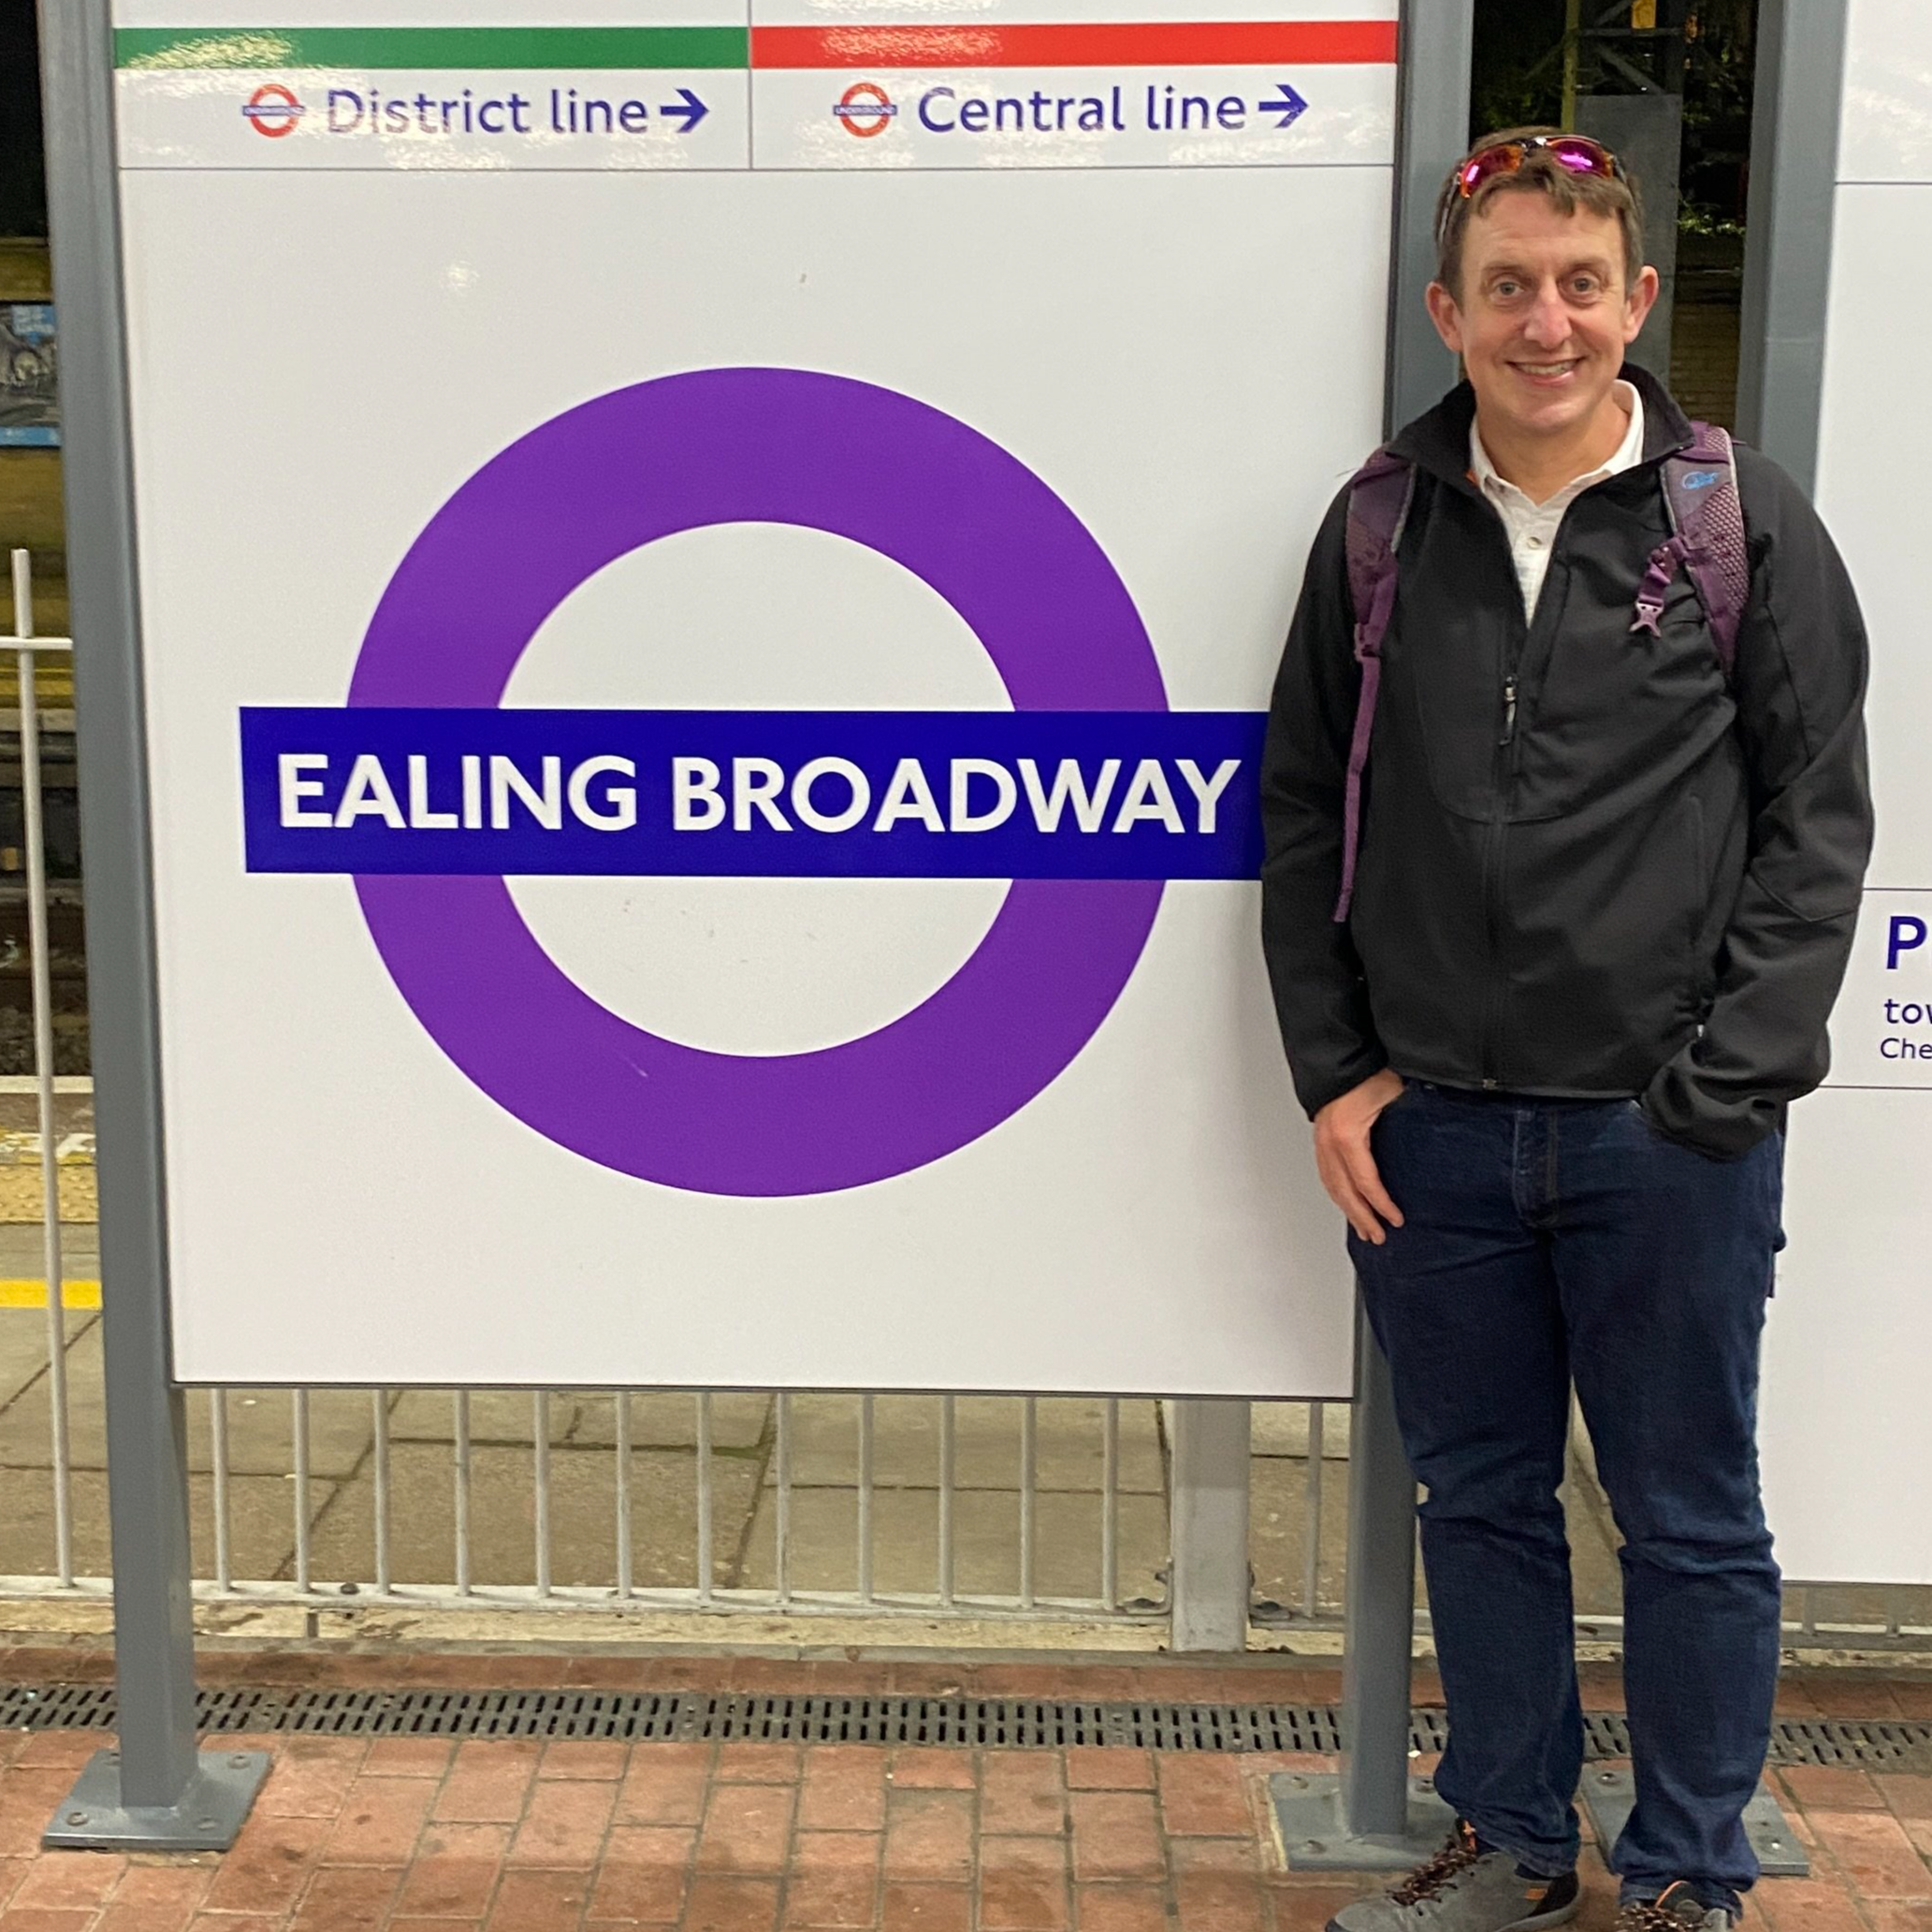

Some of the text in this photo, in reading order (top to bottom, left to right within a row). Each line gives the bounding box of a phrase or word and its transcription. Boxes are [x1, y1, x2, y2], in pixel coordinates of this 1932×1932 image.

[327, 89, 649, 134] District line
[917, 84, 1246, 133] Central line
[279, 754, 1242, 834] EALING BROADWAY
